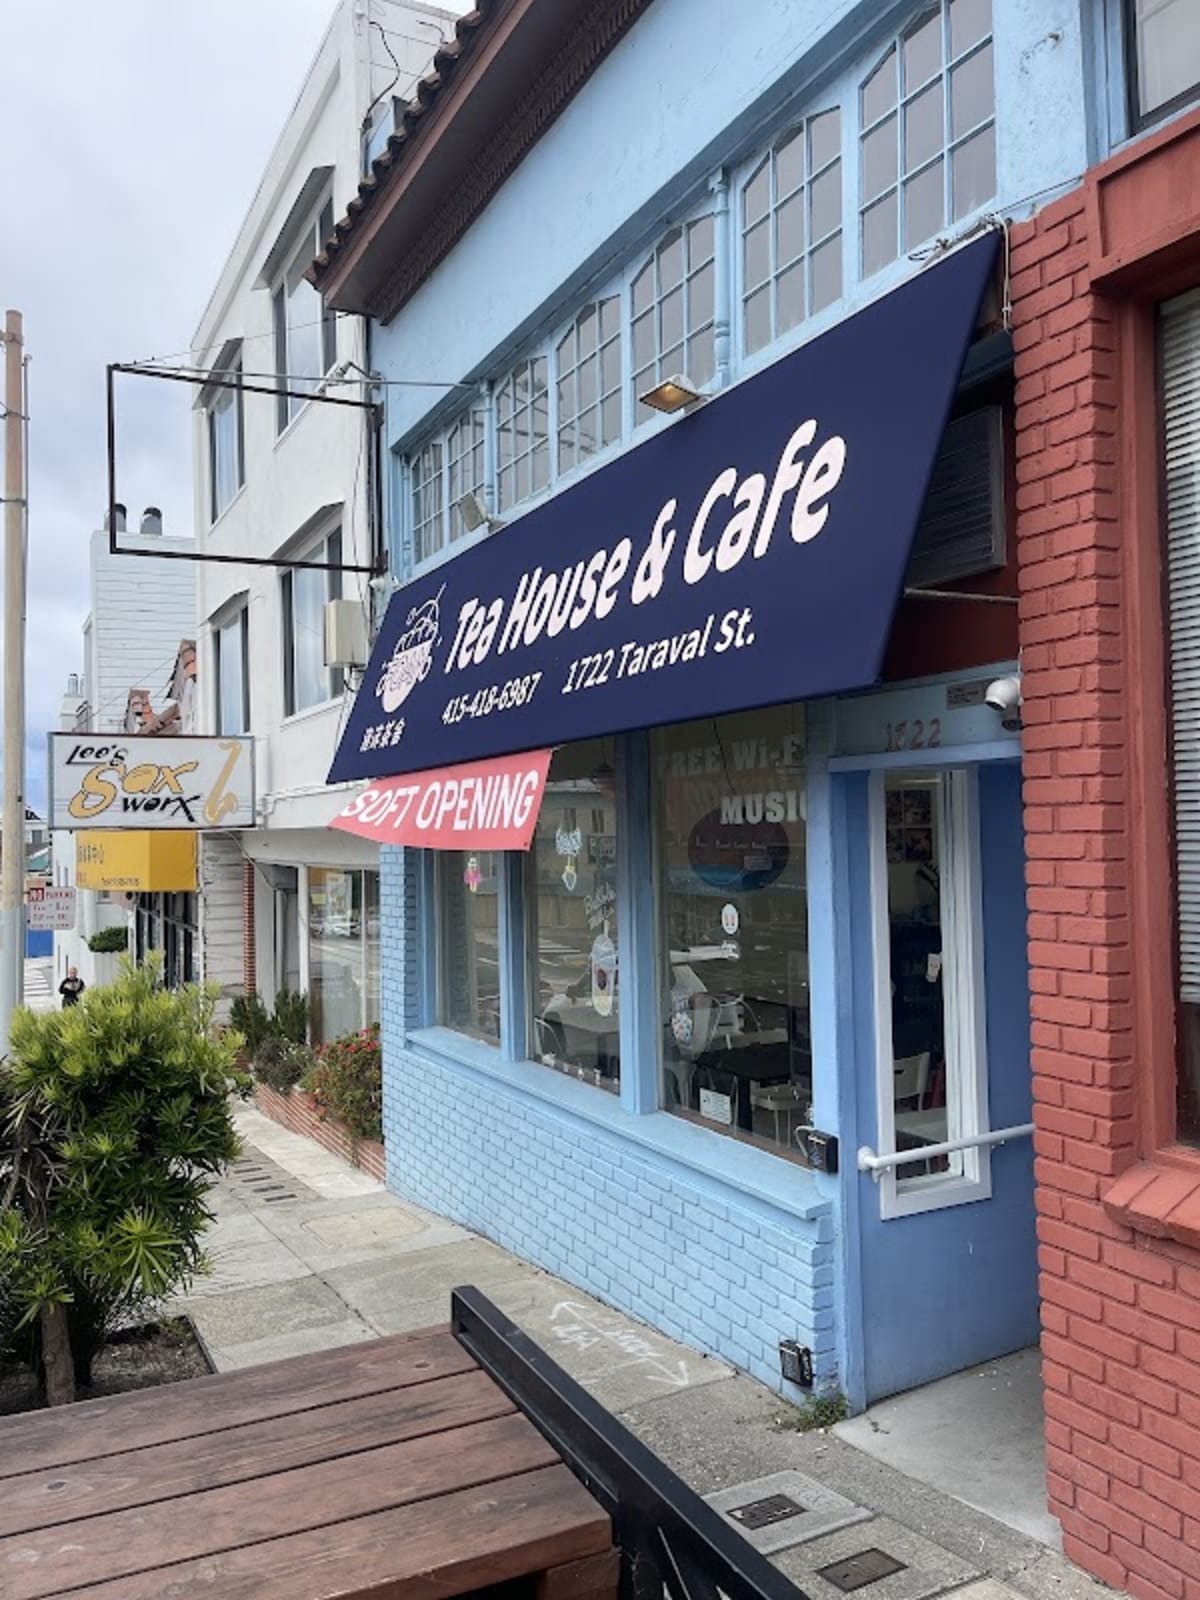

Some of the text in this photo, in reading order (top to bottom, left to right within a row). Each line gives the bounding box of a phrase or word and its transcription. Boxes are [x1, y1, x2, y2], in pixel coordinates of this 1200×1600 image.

[444, 419, 847, 674] Tea House & Cafe
[441, 606, 756, 726] 415-418-6987 1722 Taraval St.
[66, 744, 129, 767] Lee's
[68, 761, 199, 819] Sax
[341, 769, 539, 830] SOFT OPENING
